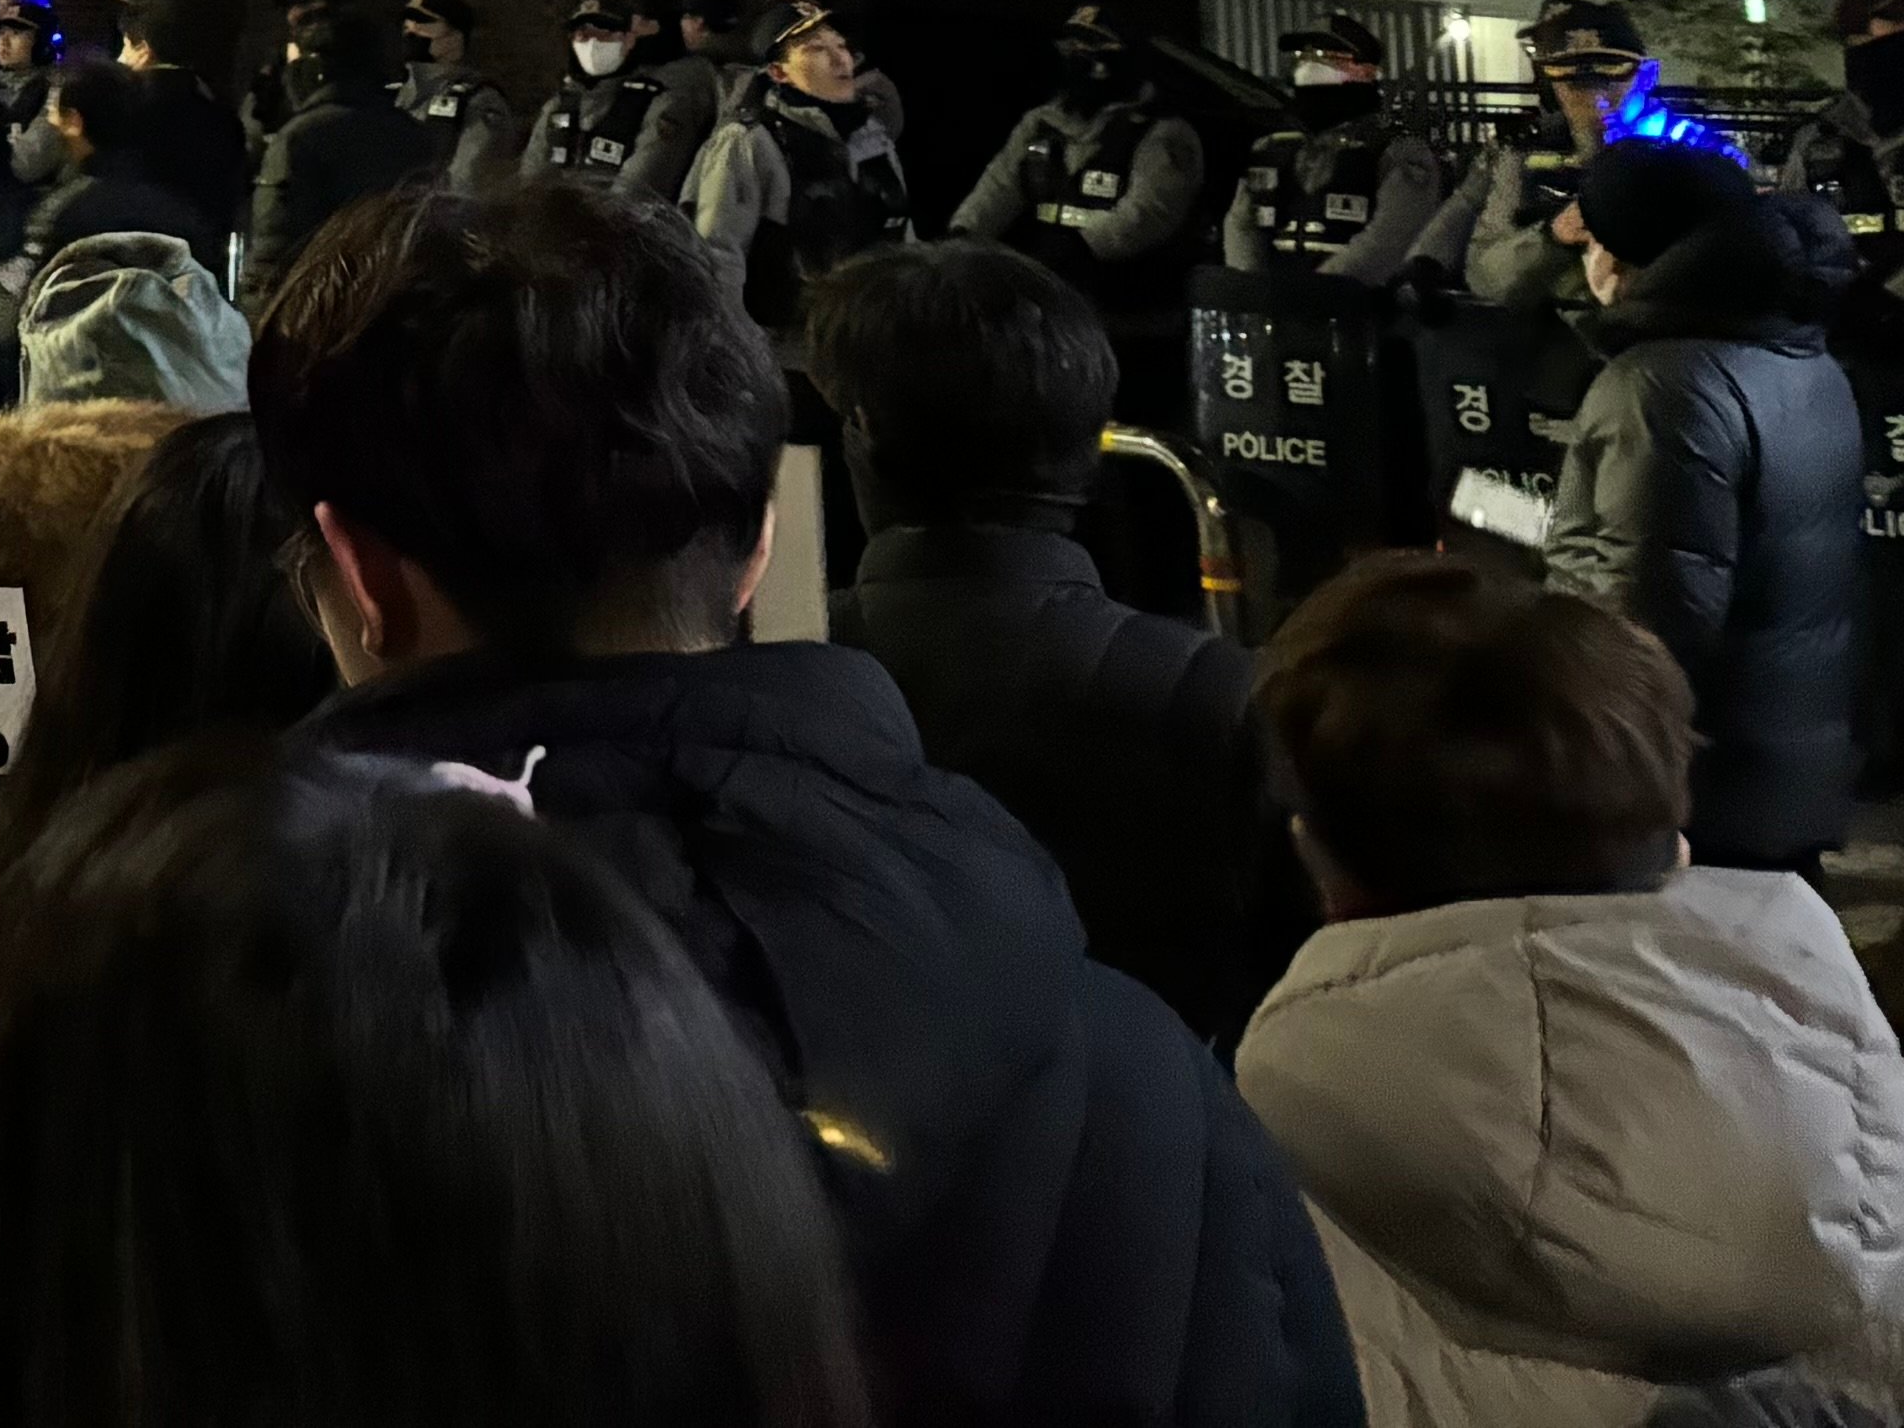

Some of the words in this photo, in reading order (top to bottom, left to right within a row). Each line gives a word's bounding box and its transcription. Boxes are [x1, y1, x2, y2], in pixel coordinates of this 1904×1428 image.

[1221, 352, 1326, 405] 경찰
[1453, 384, 1491, 434] 경
[1223, 430, 1327, 466] POLICE
